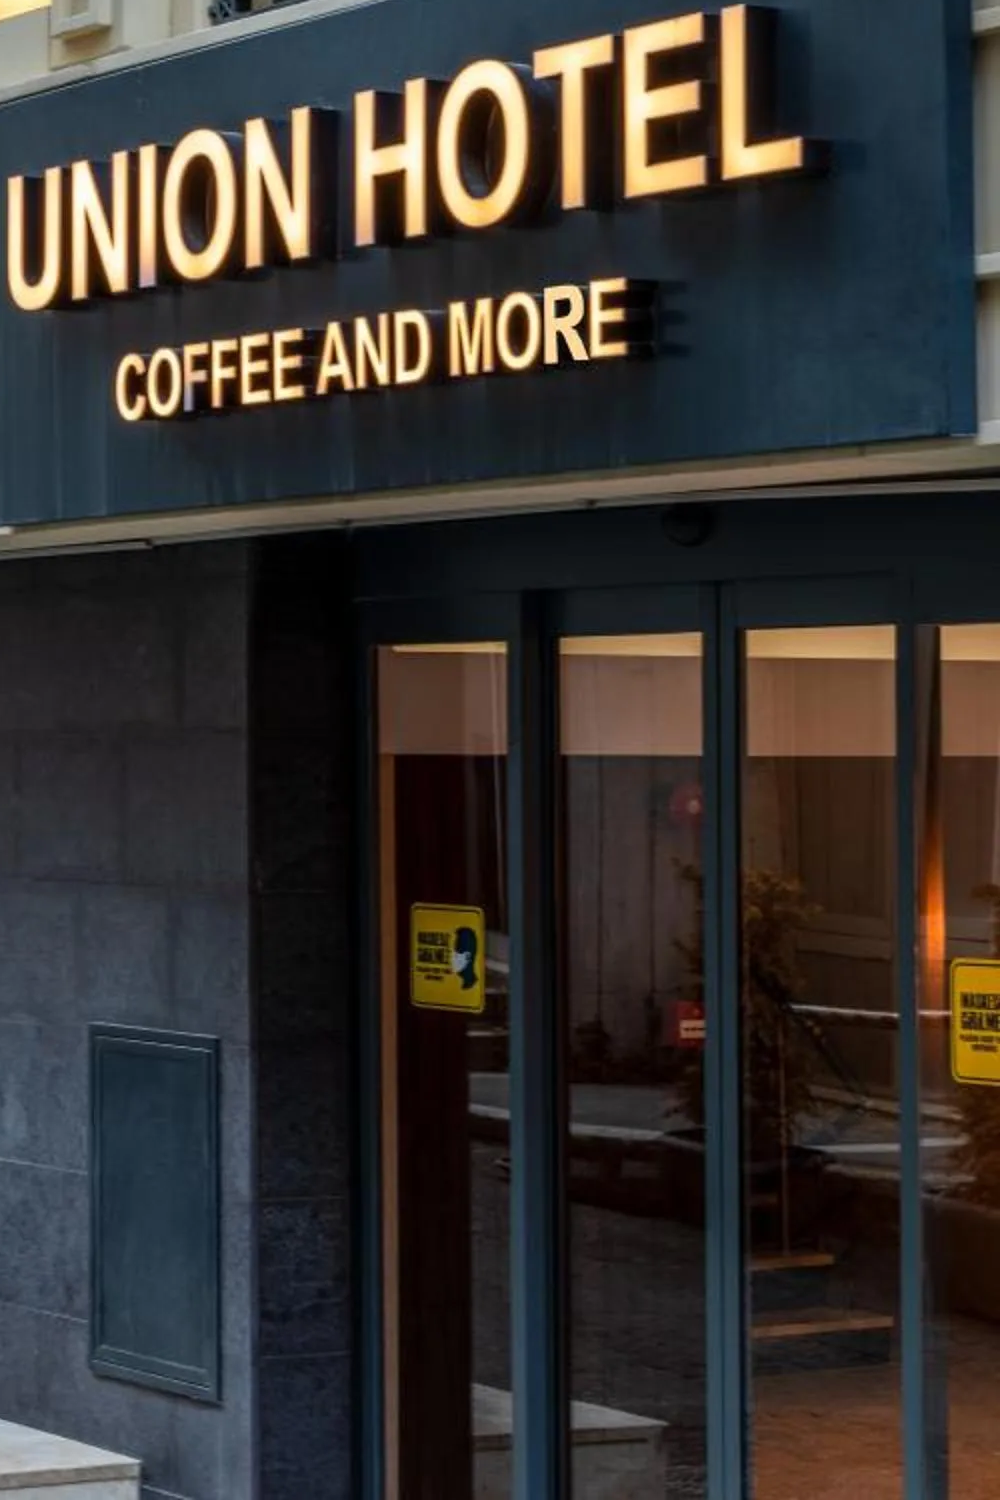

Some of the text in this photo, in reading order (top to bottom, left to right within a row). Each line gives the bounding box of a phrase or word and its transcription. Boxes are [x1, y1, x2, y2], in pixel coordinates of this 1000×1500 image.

[6, 2, 803, 312] UNION HOTEL
[114, 276, 628, 422] COFFEE AND MORE
